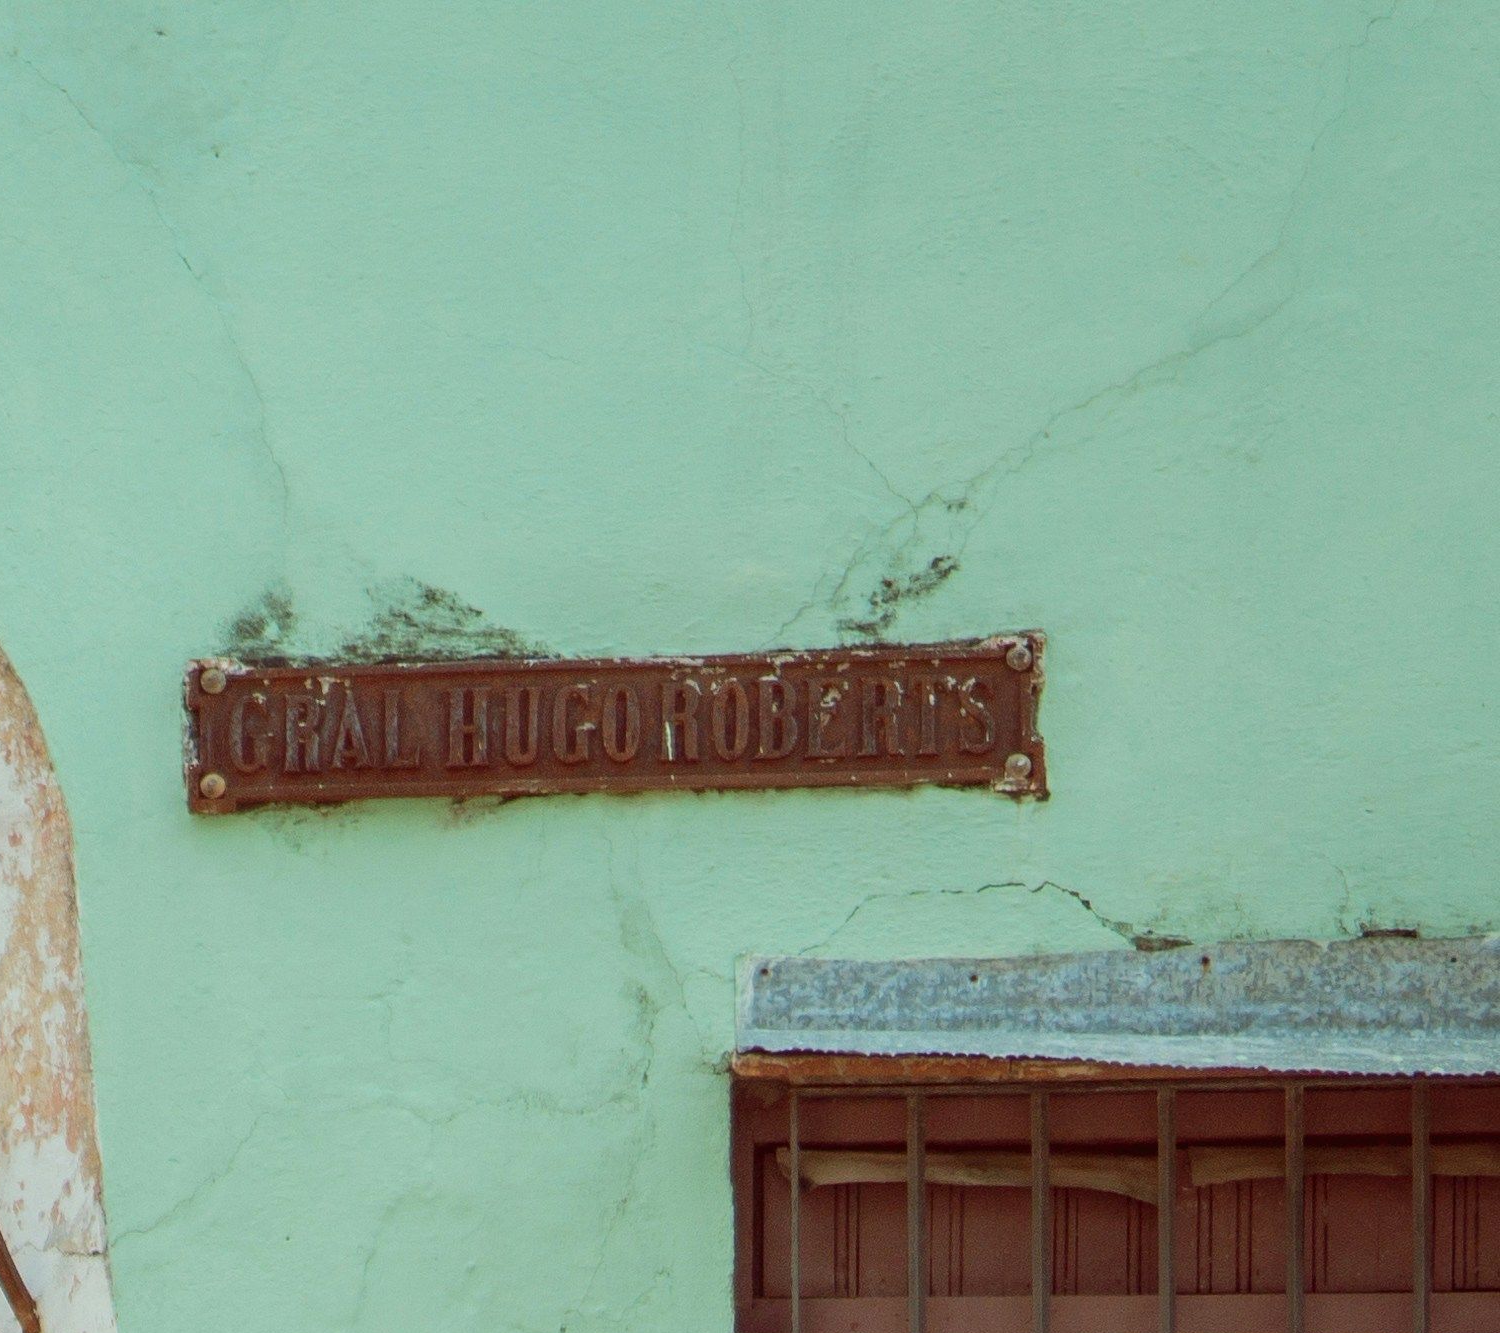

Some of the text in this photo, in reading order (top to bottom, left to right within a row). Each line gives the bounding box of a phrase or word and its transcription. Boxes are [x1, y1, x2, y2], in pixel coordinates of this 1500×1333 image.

[229, 676, 997, 773] GRAL HUGO ROBERTS
